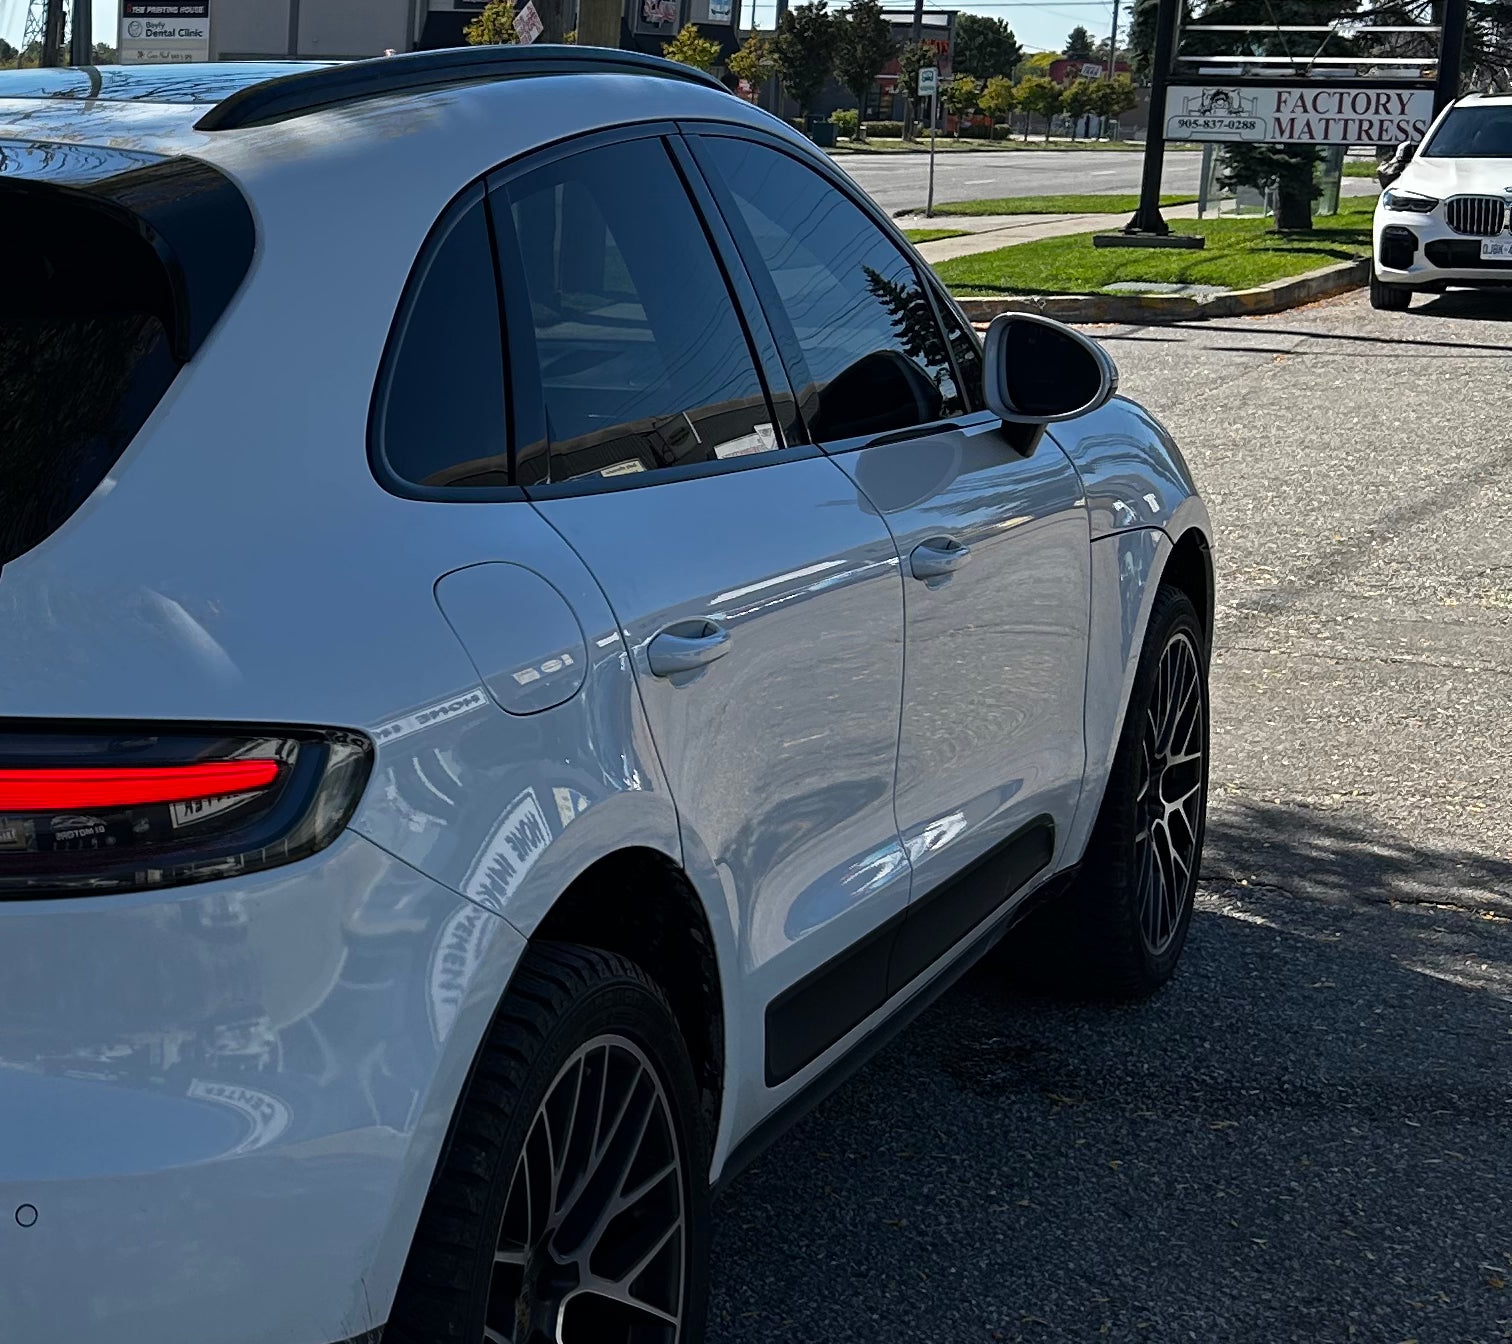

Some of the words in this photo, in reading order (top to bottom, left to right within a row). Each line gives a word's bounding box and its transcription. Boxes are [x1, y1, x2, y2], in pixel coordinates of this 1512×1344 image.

[145, 28, 175, 37] Dental
[177, 28, 204, 37] Clinic
[1272, 89, 1417, 117] FACTORY
[1177, 117, 1257, 132] 905-837-0288
[1270, 116, 1429, 144] MATTRESS
